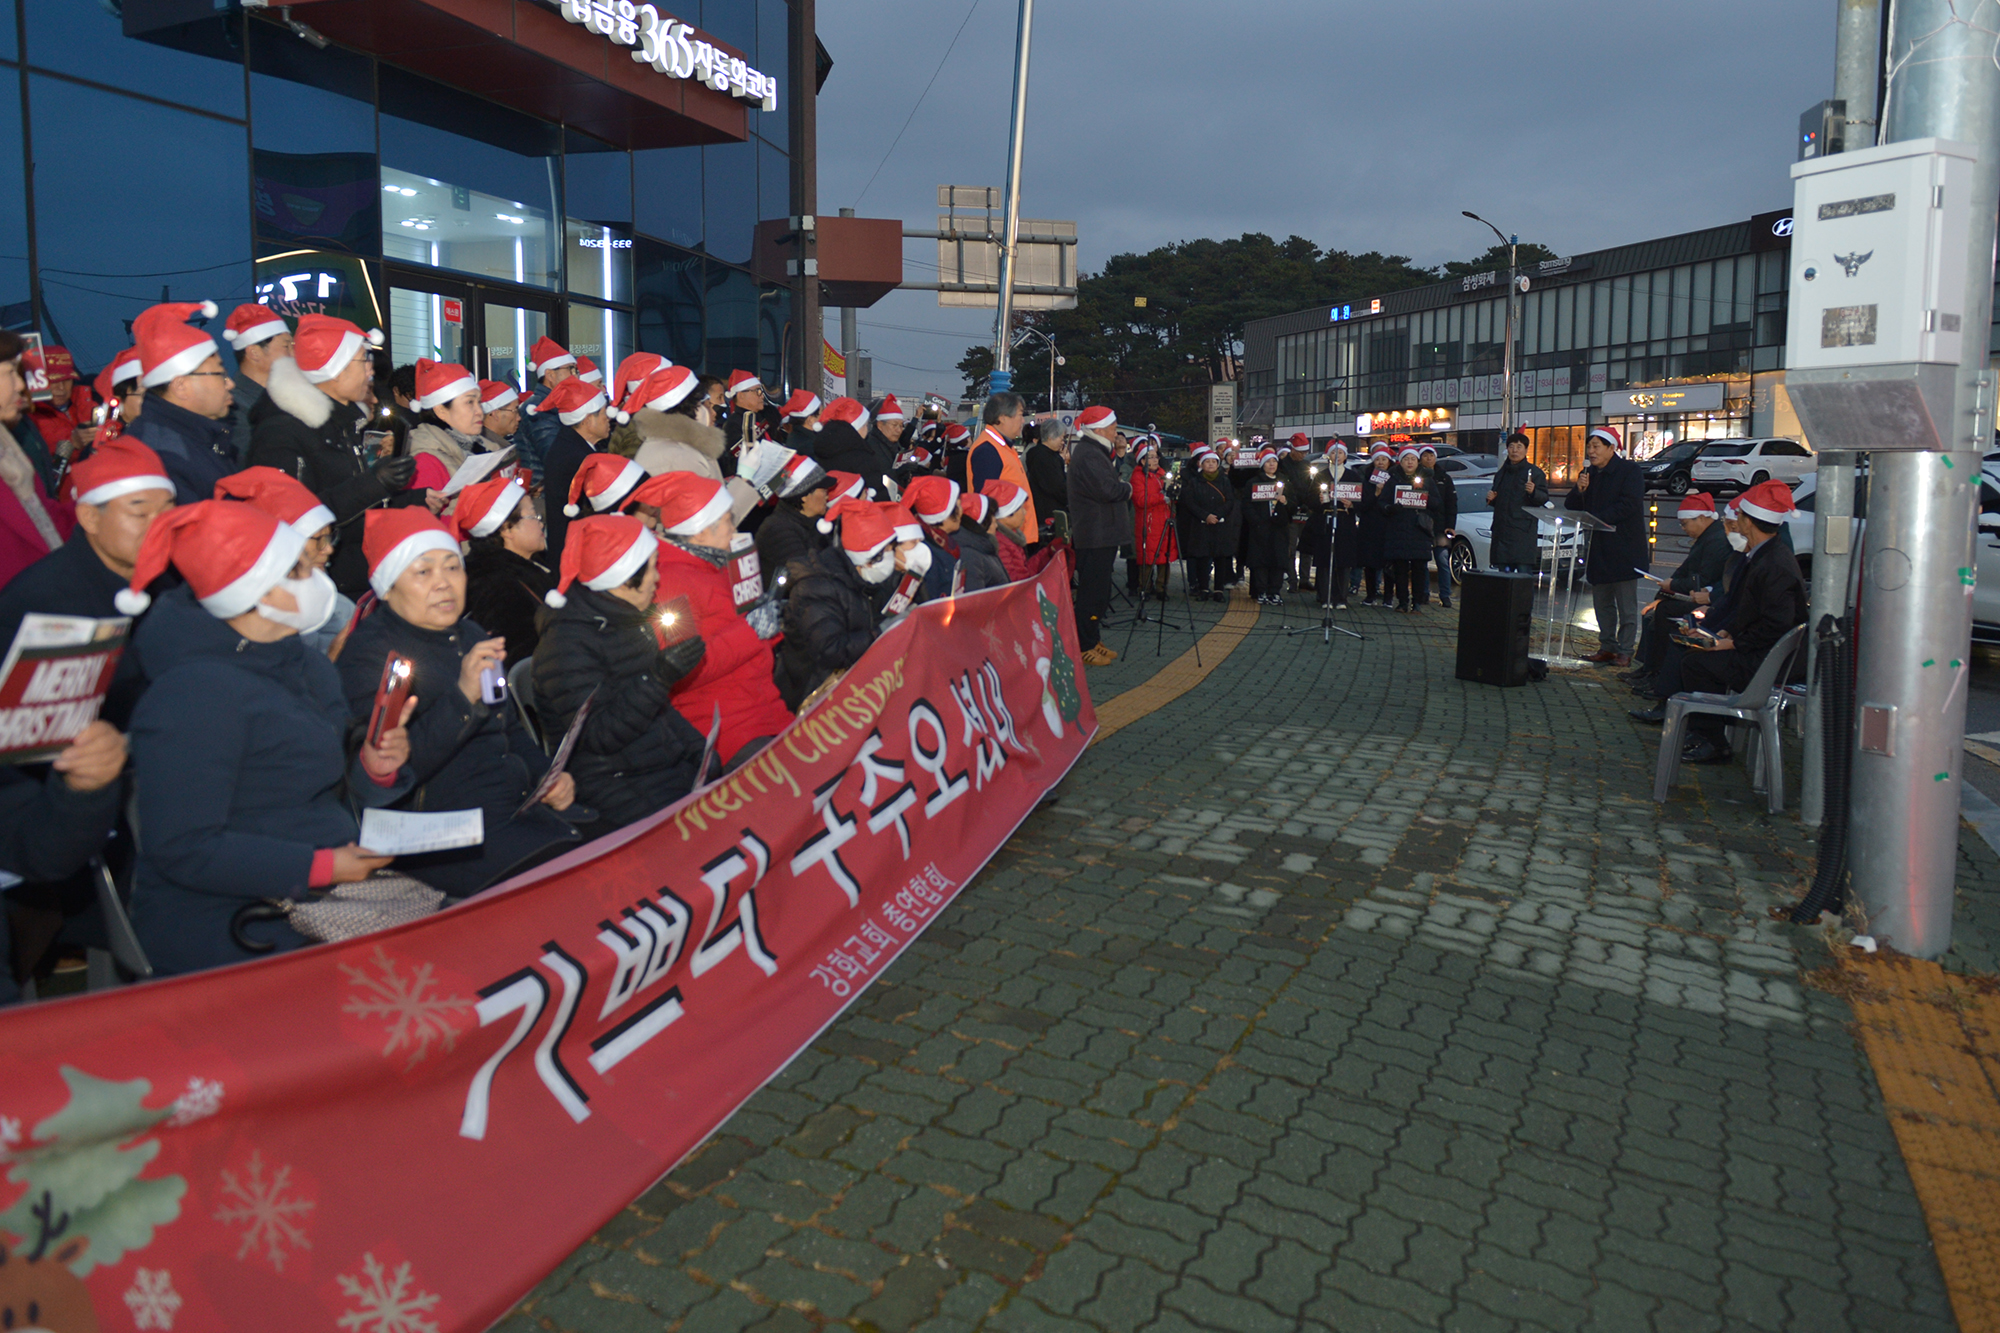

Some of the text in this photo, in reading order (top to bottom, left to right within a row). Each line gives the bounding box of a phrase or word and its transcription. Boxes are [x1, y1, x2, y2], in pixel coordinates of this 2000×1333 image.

[640, 4, 694, 78] 365
[694, 40, 777, 111] 자동화코너
[1539, 257, 1572, 270] Samsung
[1257, 484, 1274, 492] MERRY
[1402, 491, 1421, 499] MERRY
[20, 653, 109, 704] MERRY
[675, 744, 801, 841] Merry
[459, 828, 778, 1142] 기쁘다
[789, 727, 906, 909] 구주
[808, 861, 957, 997] 강화교회 총연합회
